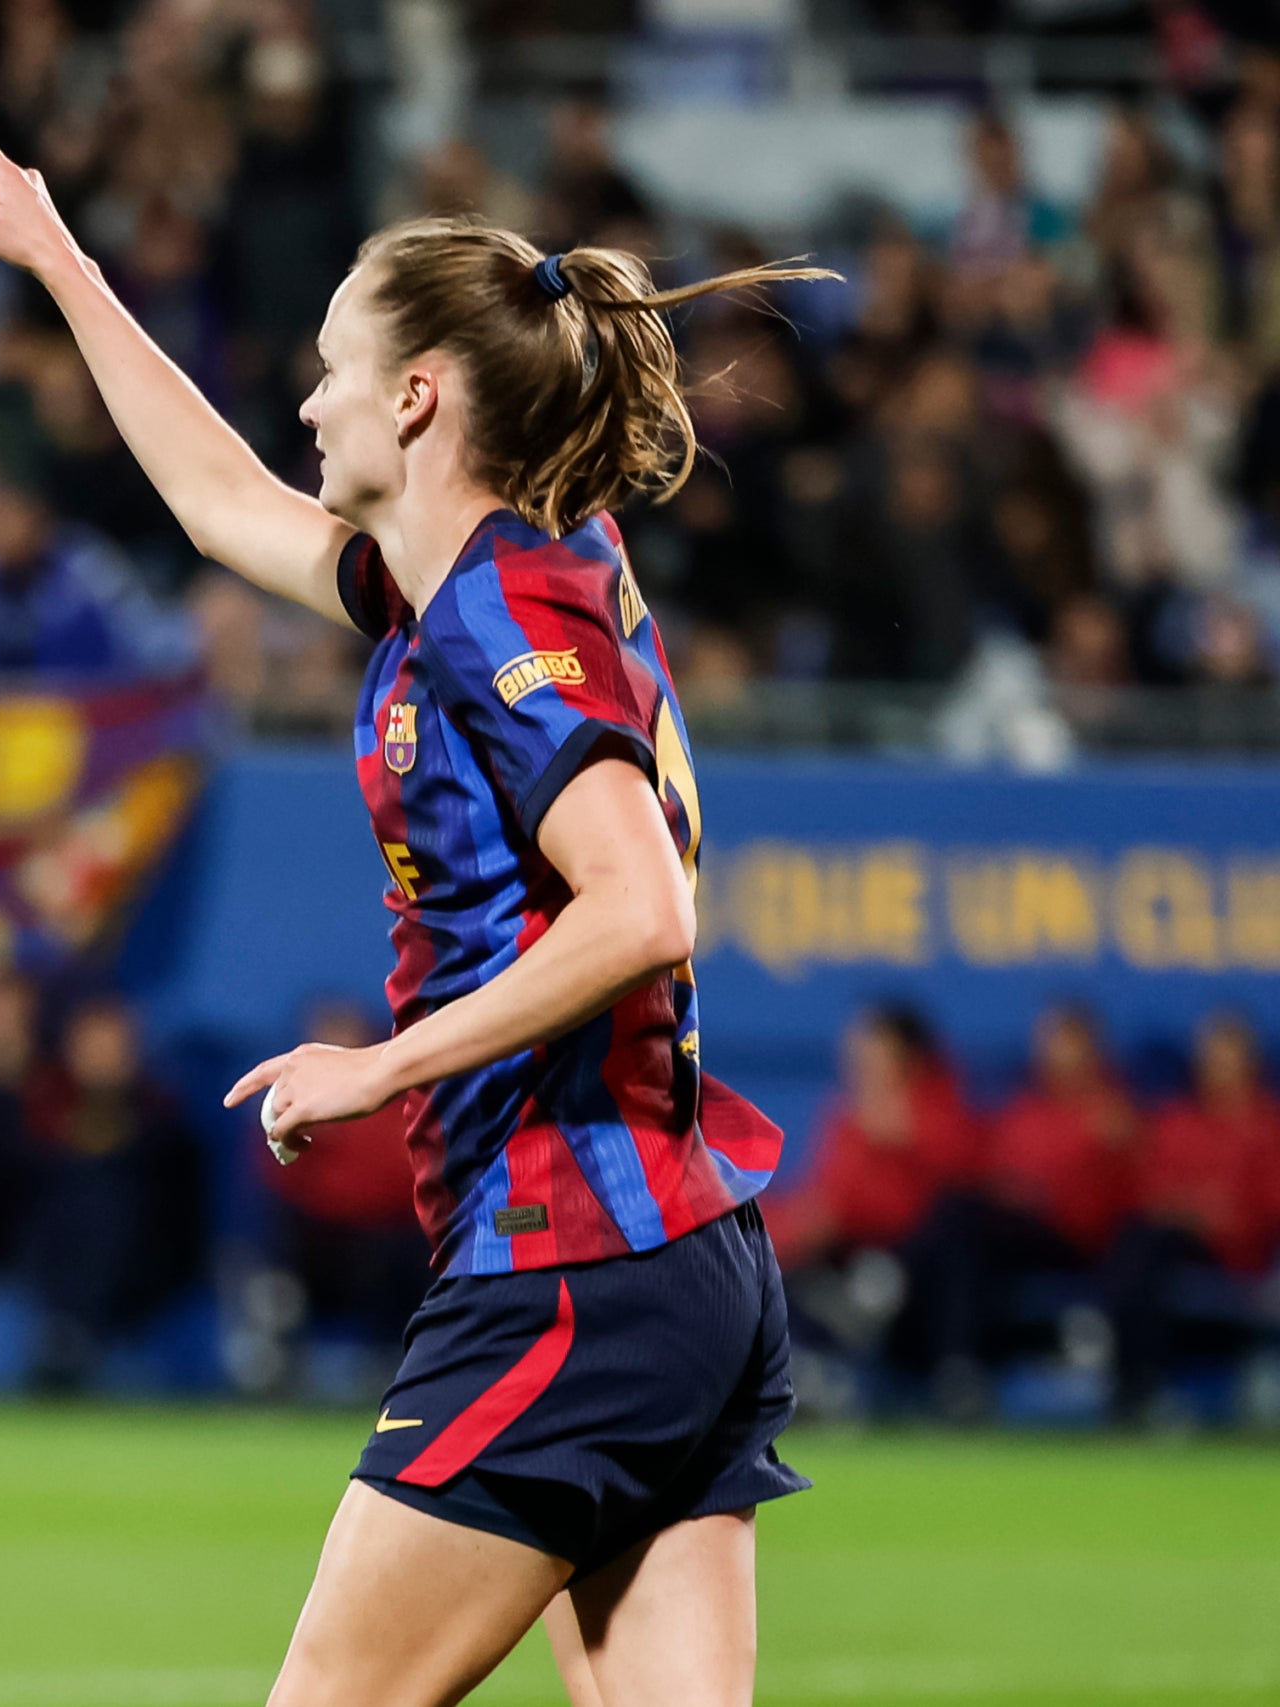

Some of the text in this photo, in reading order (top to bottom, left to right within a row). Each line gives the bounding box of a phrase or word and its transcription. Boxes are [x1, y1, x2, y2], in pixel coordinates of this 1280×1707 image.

[496, 655, 583, 704] BIMBO
[735, 842, 928, 976] QUE
[950, 848, 1100, 966] UN
